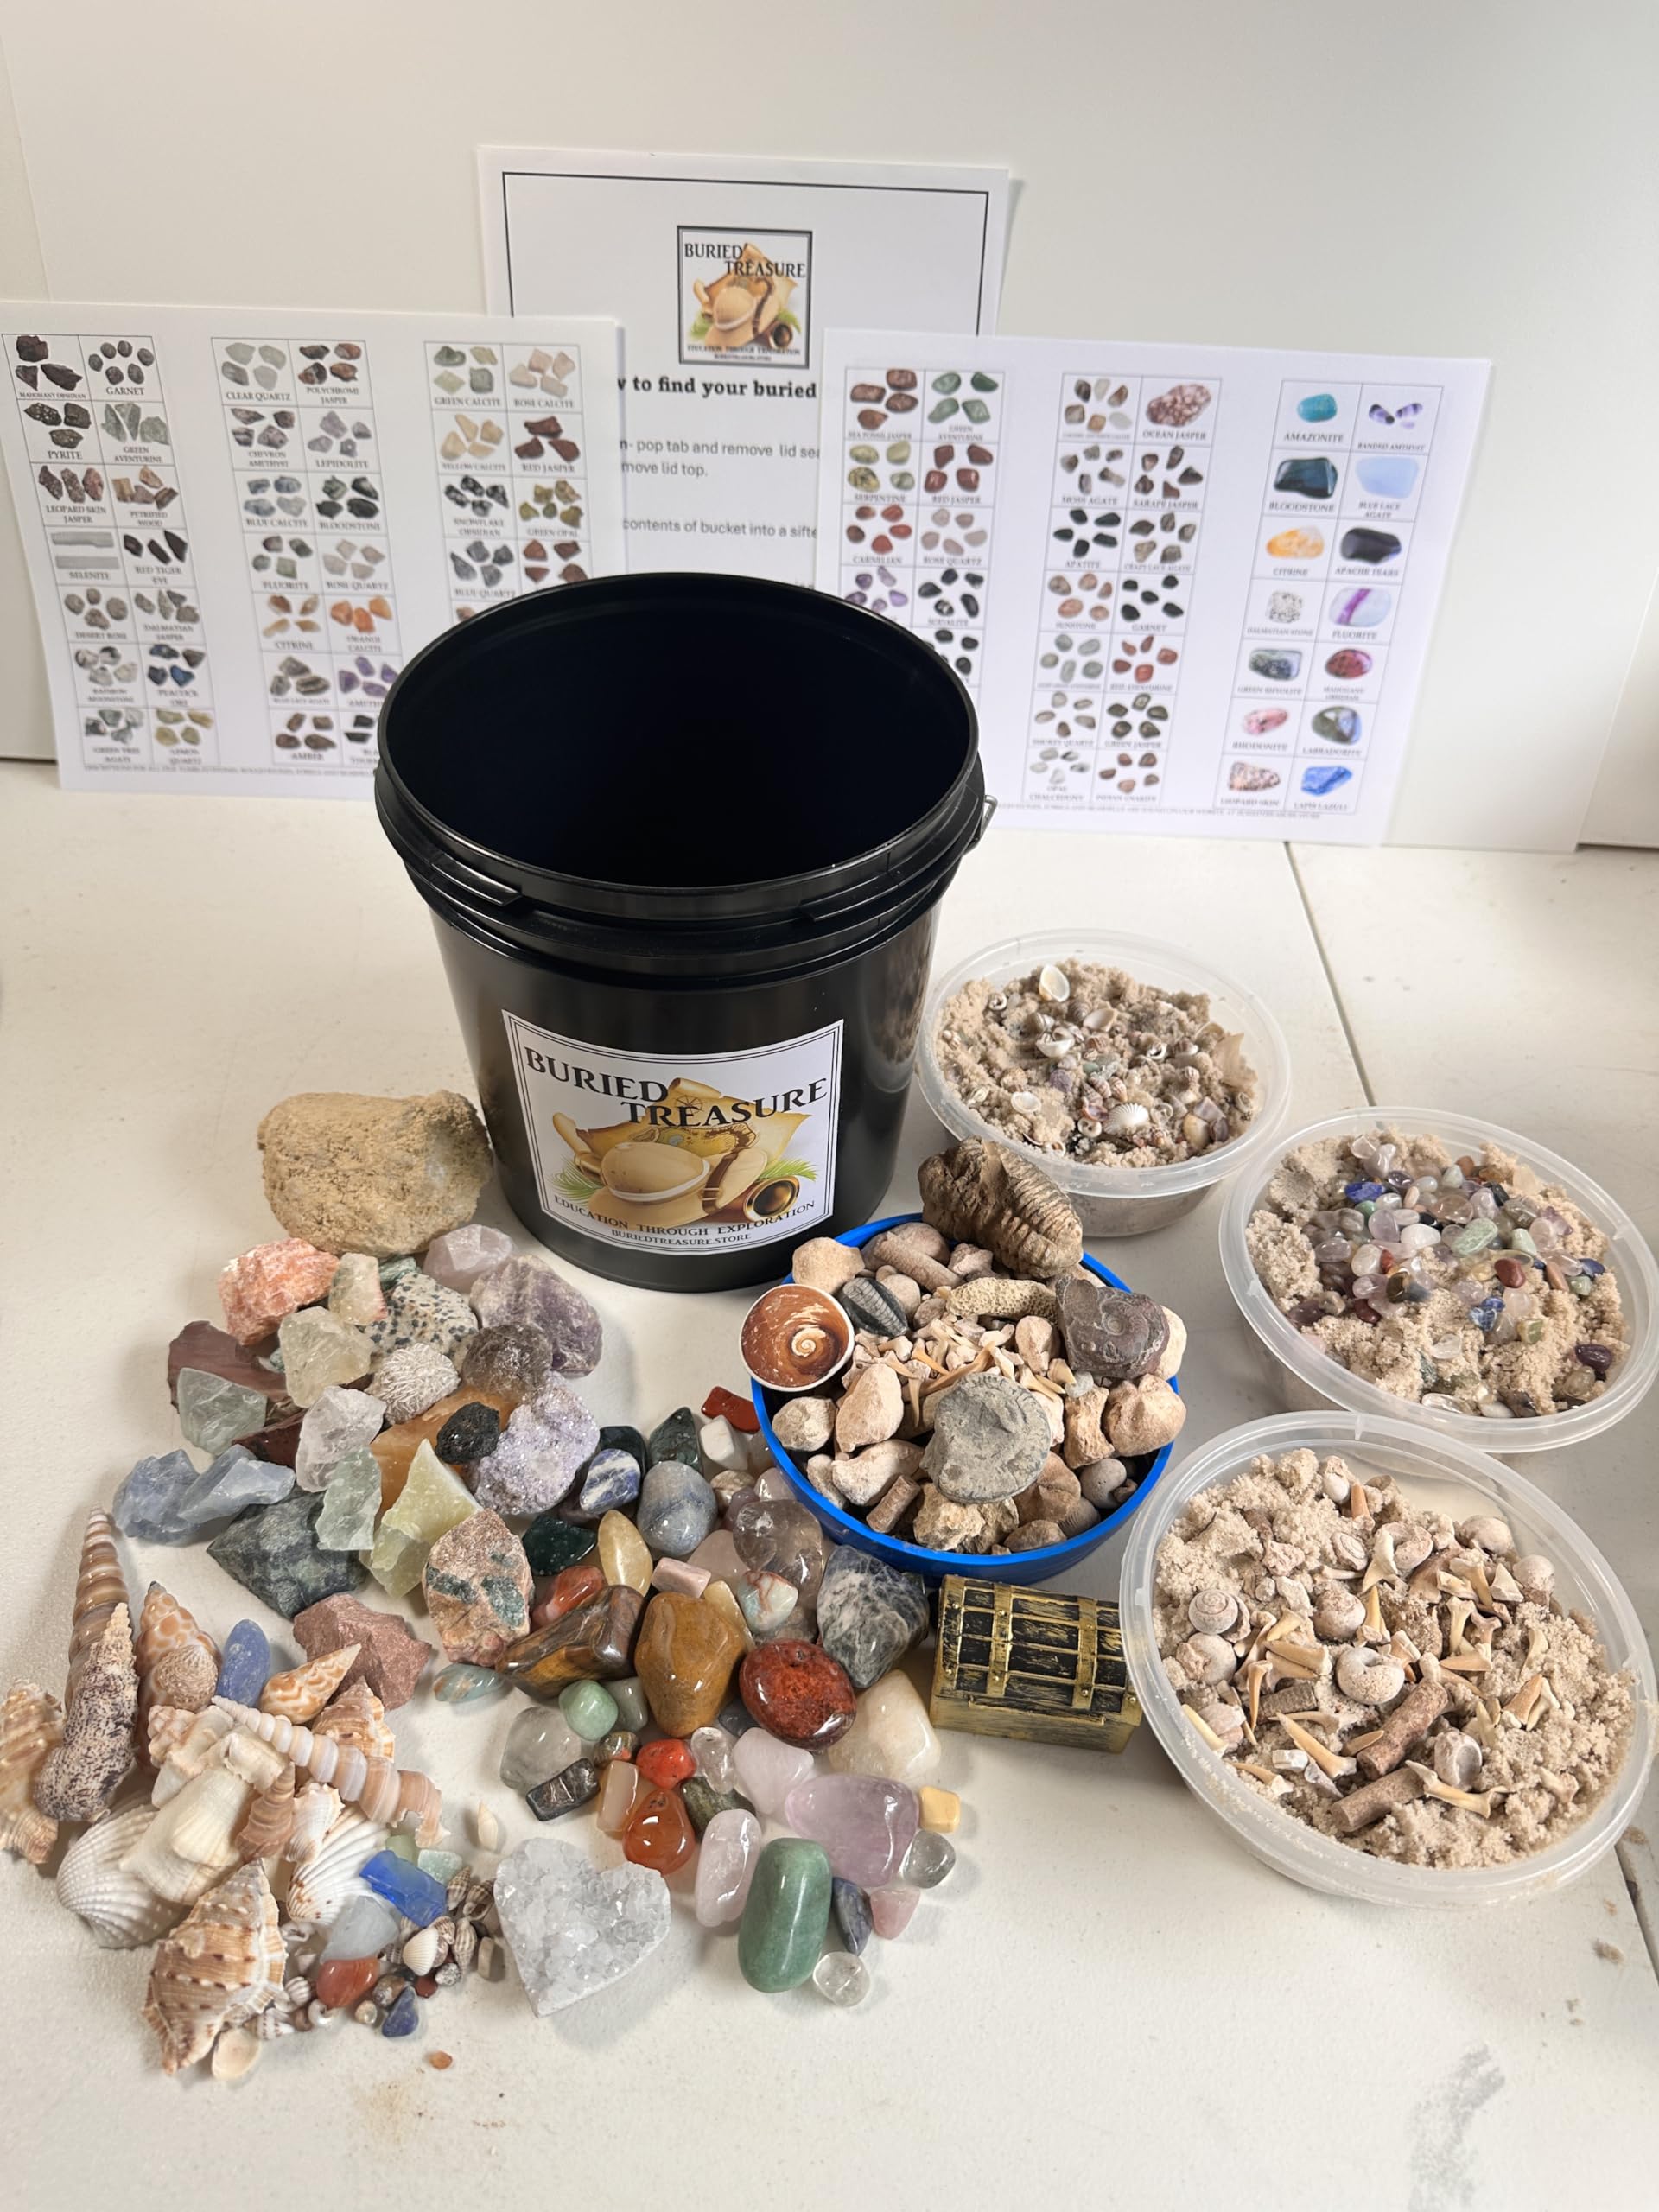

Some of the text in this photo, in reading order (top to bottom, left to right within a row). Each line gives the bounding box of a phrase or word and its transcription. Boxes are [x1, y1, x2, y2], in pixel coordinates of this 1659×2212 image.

[684, 243, 742, 259] BURIED
[724, 260, 805, 277] TREASURE
[633, 378, 652, 391] to
[658, 378, 696, 393] find
[702, 381, 747, 398] your
[753, 380, 817, 398] buried
[1284, 434, 1344, 442] AMAZONITE
[48, 451, 82, 460] PYRITE
[637, 441, 663, 454] pop
[667, 442, 689, 454] tab
[693, 442, 718, 454] and
[722, 444, 772, 456] remove
[779, 445, 796, 458] lid
[315, 460, 368, 468] LEPIDOLITE
[621, 463, 708, 477] move lid top.
[1269, 502, 1335, 512] BLOODSTONE
[624, 520, 681, 531] contents
[684, 521, 697, 531] of
[701, 522, 746, 535] bucket
[750, 524, 775, 537] into
[779, 527, 787, 537] a
[1332, 631, 1376, 639] FLUORITE
[1233, 742, 1287, 751] RHODONITE
[524, 1046, 667, 1102] BURIED
[621, 1078, 827, 1127] TREASURE
[555, 1196, 815, 1236] EDUCATION THROUGH EXPLORATION
[612, 1230, 751, 1245] BURIEDTREASURE.STORE
